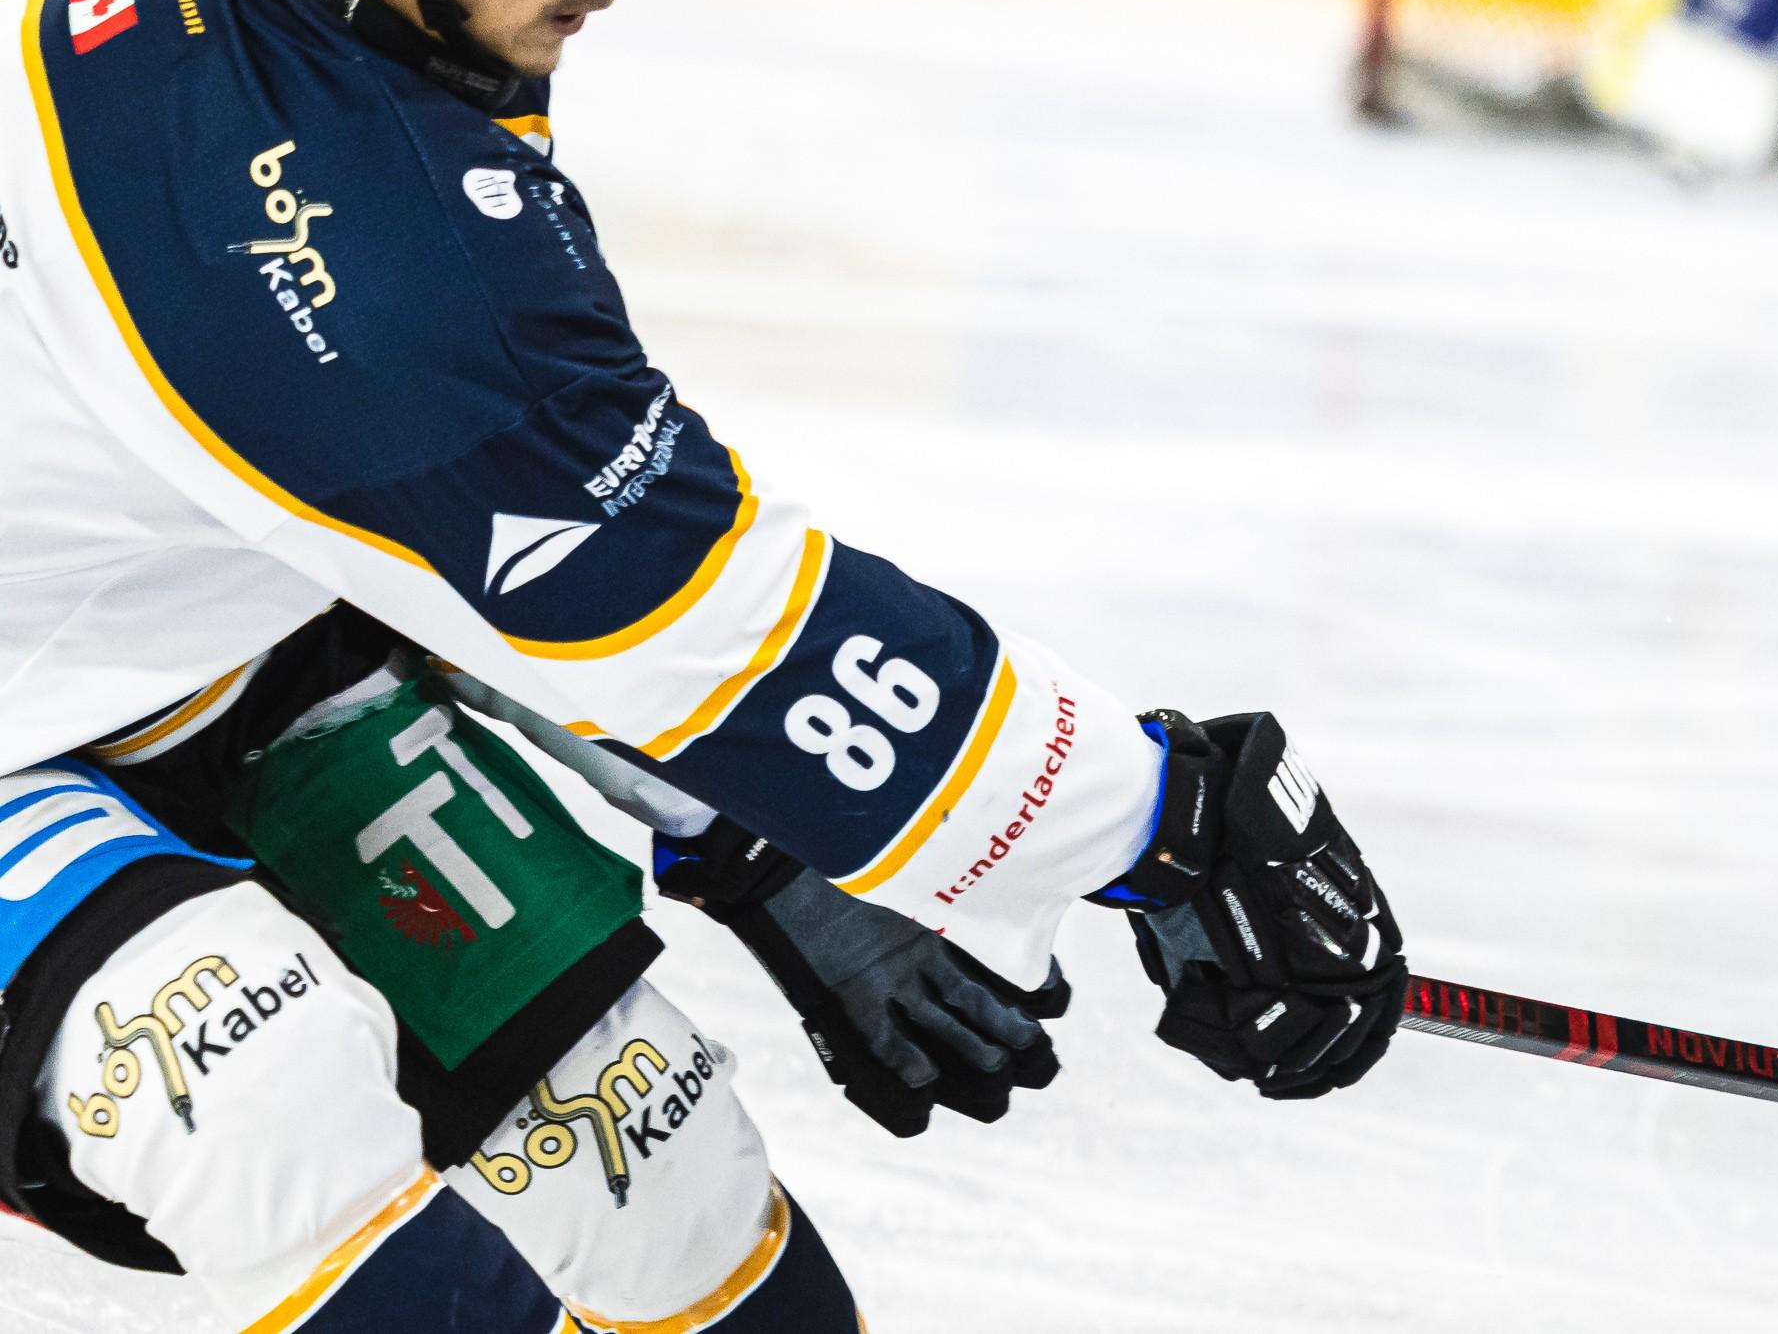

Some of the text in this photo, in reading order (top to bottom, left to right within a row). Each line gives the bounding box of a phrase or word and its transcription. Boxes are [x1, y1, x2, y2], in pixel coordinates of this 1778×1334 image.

[258, 257, 339, 364] Kabel
[783, 633, 941, 792] 86
[180, 951, 321, 1077] Kabel
[624, 1032, 718, 1160] Kabel
